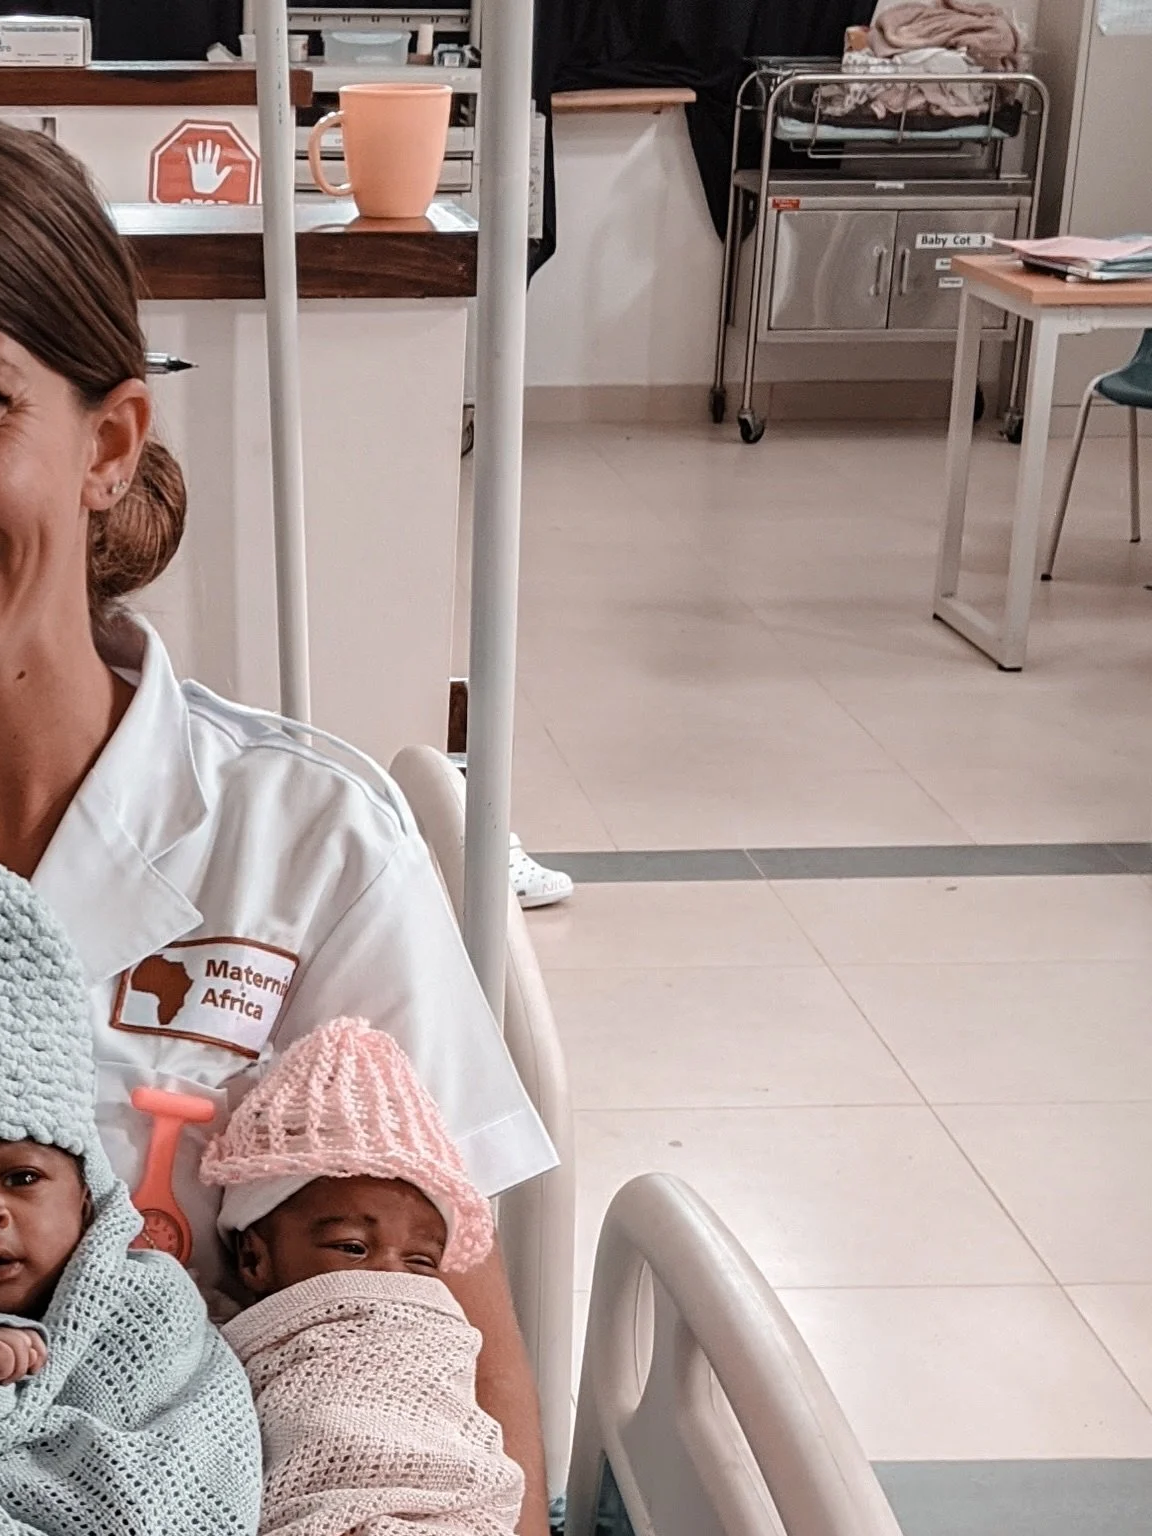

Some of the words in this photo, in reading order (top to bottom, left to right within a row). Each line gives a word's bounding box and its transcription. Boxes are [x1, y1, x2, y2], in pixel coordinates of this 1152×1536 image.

[922, 233, 947, 247] Baby
[953, 235, 970, 245] Cot
[201, 987, 264, 1020] Africa
